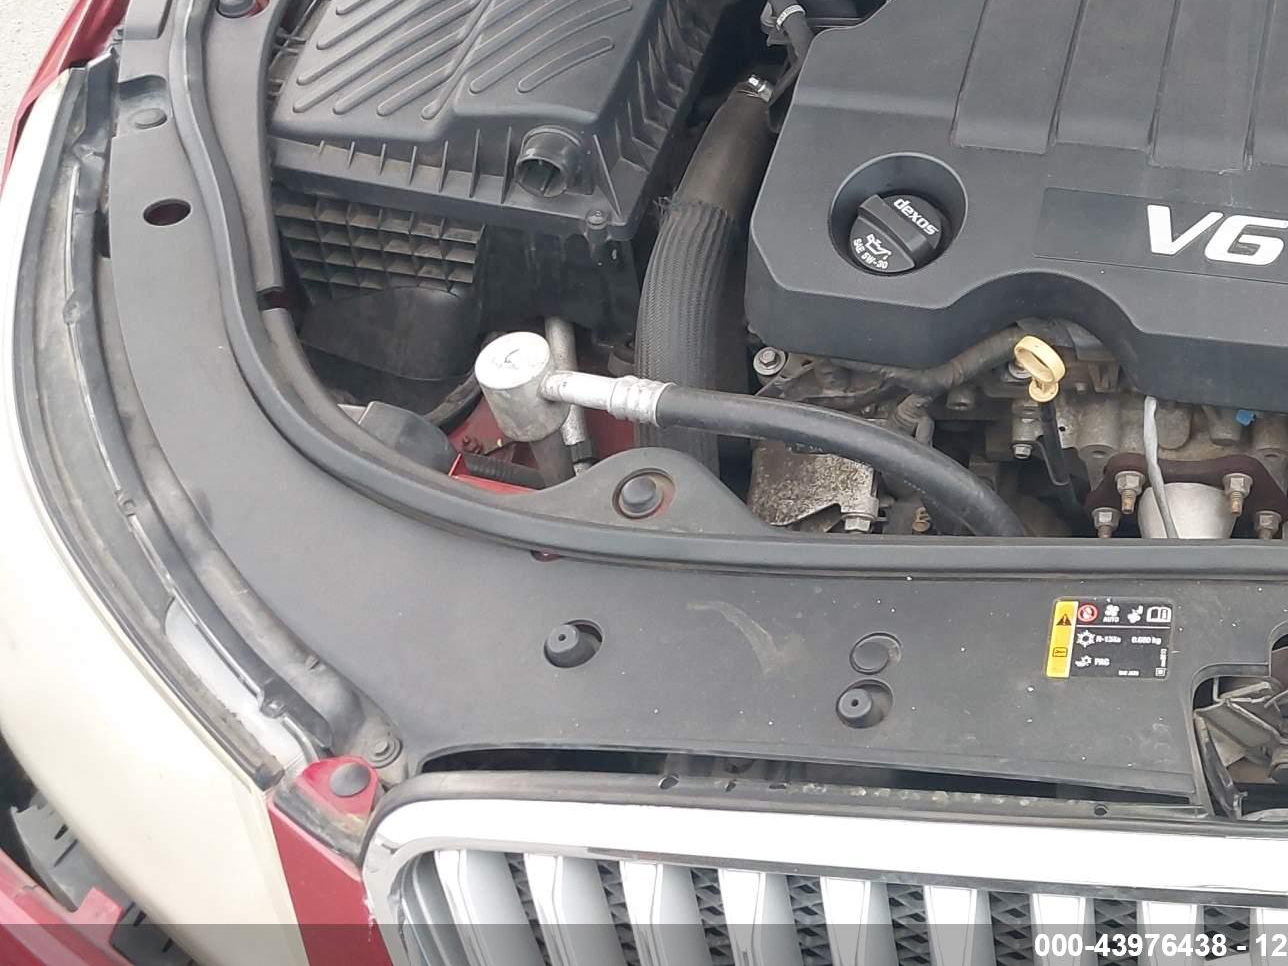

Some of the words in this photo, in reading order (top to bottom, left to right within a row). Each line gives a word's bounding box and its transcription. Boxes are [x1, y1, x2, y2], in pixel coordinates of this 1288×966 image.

[893, 198, 939, 235] dexos
[853, 238, 865, 254] SAE
[861, 251, 888, 269] 5W-30
